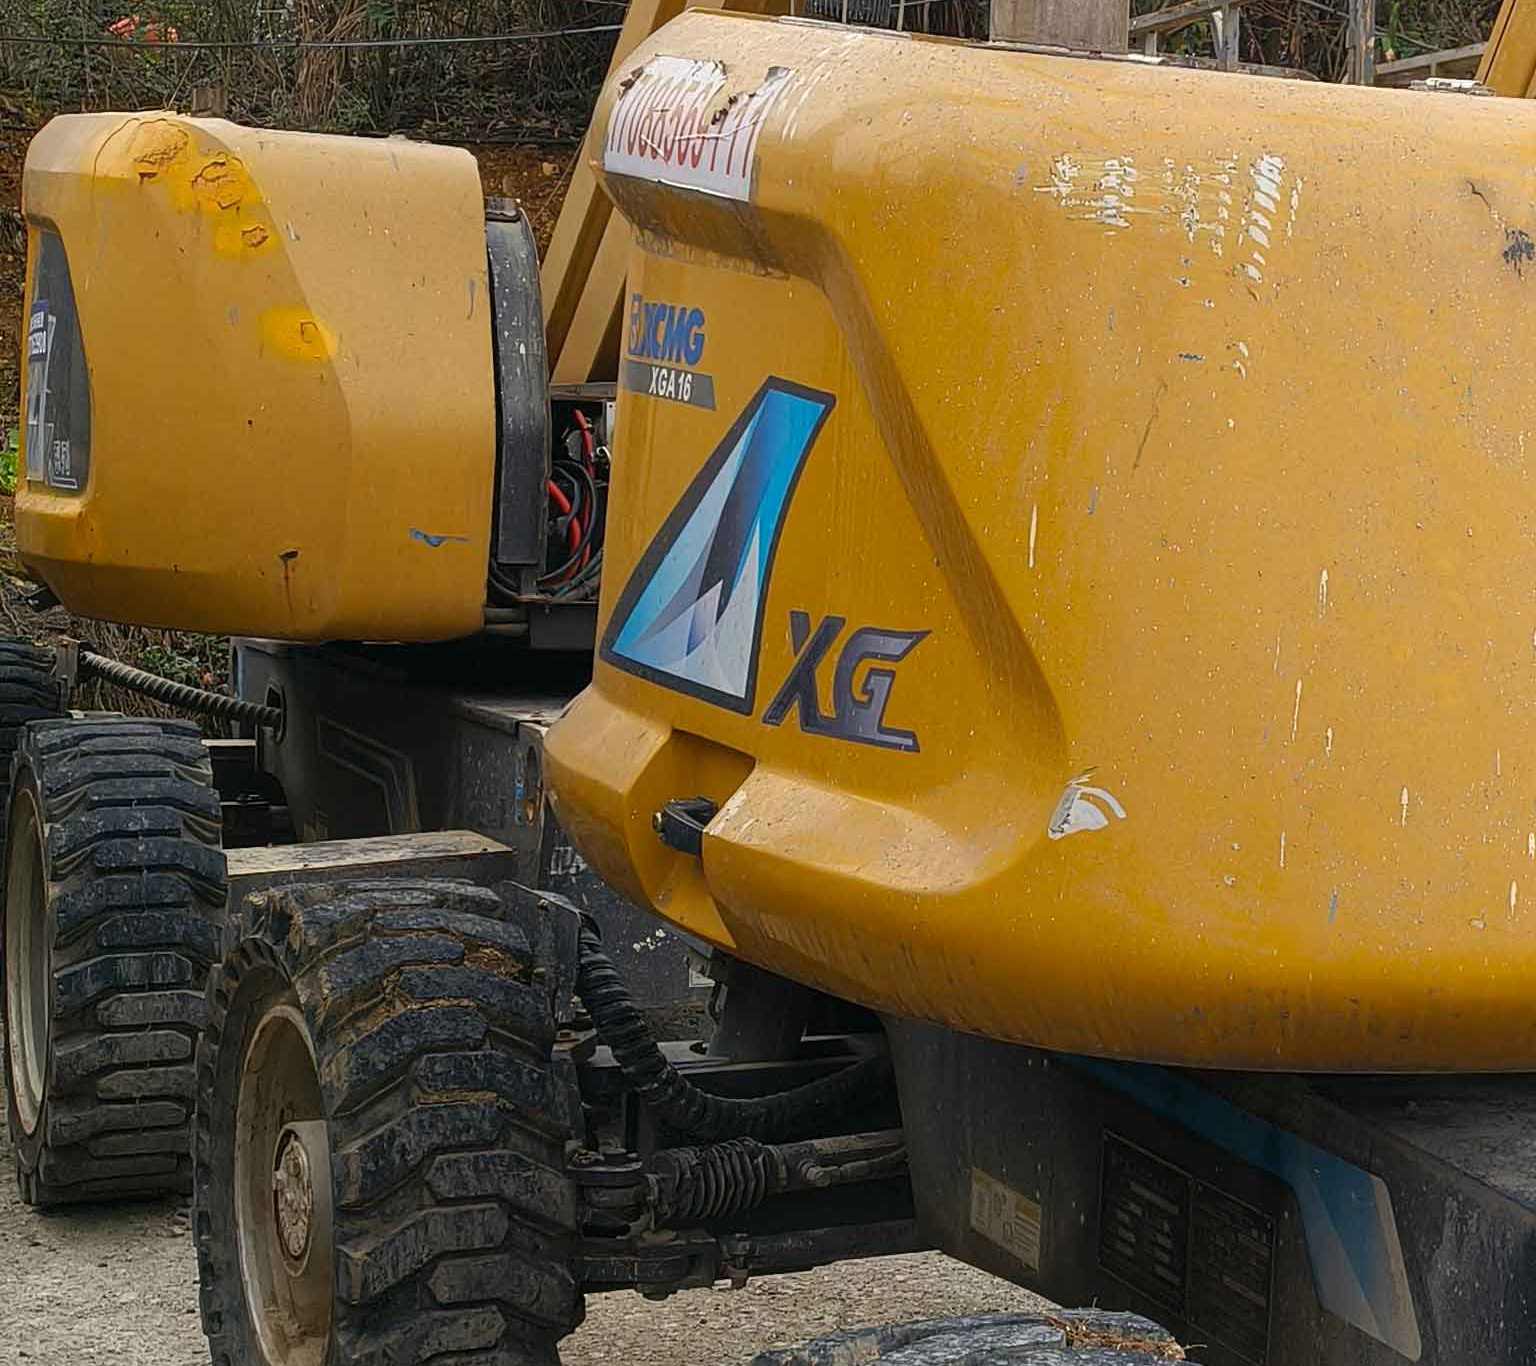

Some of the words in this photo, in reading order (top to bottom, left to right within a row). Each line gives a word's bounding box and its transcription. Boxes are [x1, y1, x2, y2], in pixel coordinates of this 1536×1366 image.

[640, 302, 706, 365] XCMG
[648, 366, 693, 402] XGA16
[761, 610, 933, 753] XG
